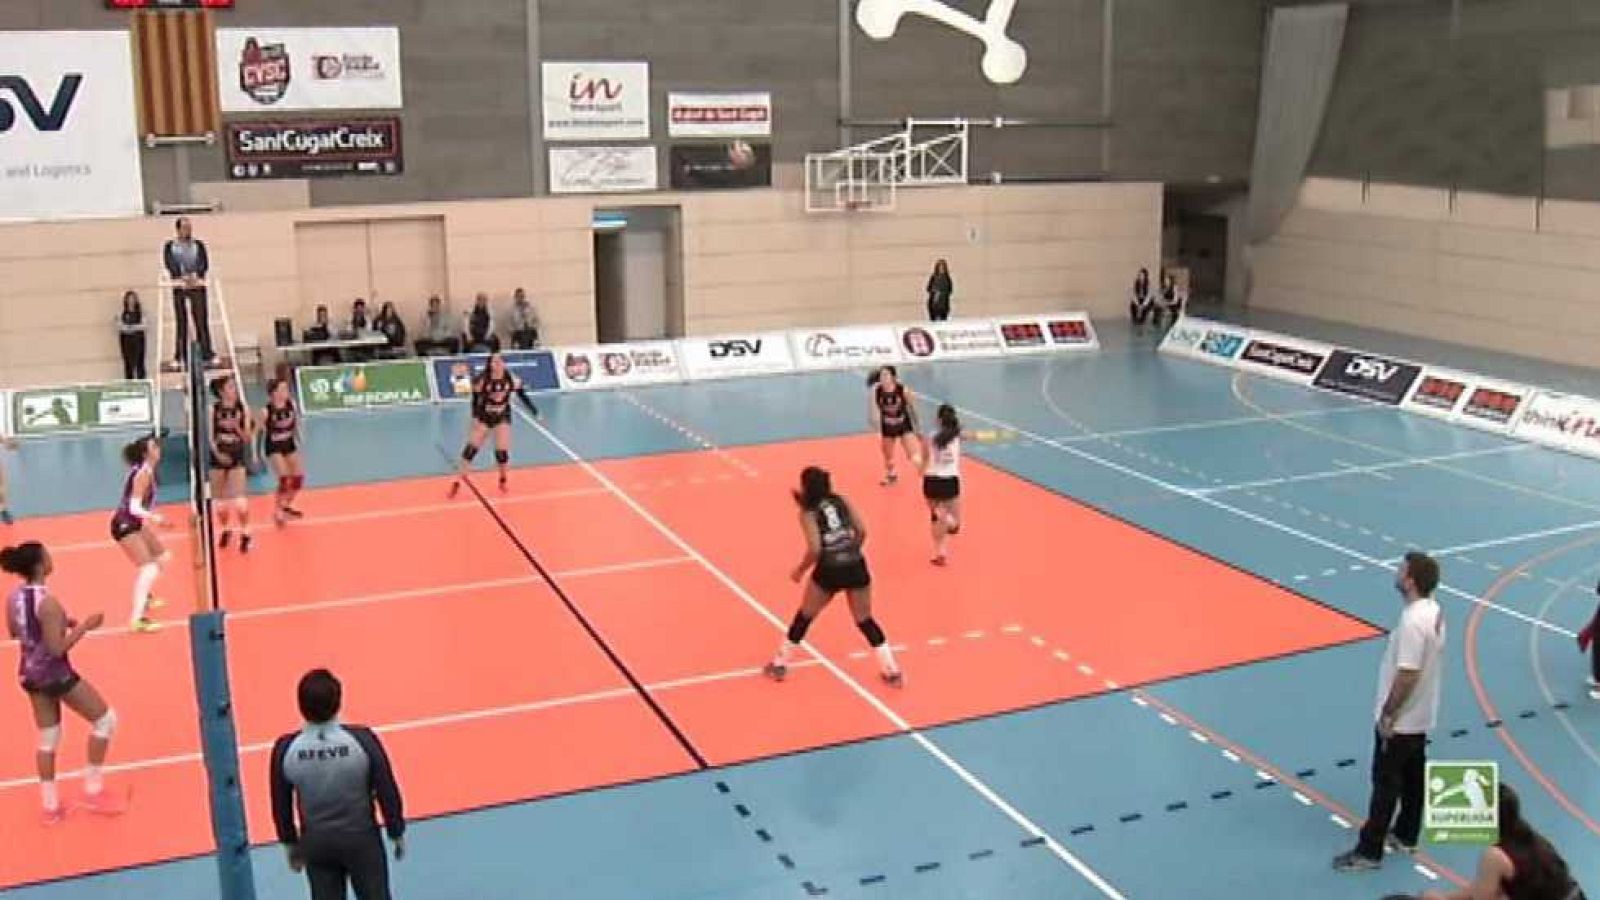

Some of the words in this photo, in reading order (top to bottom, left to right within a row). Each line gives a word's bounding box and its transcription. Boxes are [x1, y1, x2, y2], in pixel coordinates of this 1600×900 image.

[570, 72, 622, 99] in
[709, 339, 761, 358] DSV
[1345, 357, 1400, 381] DSV
